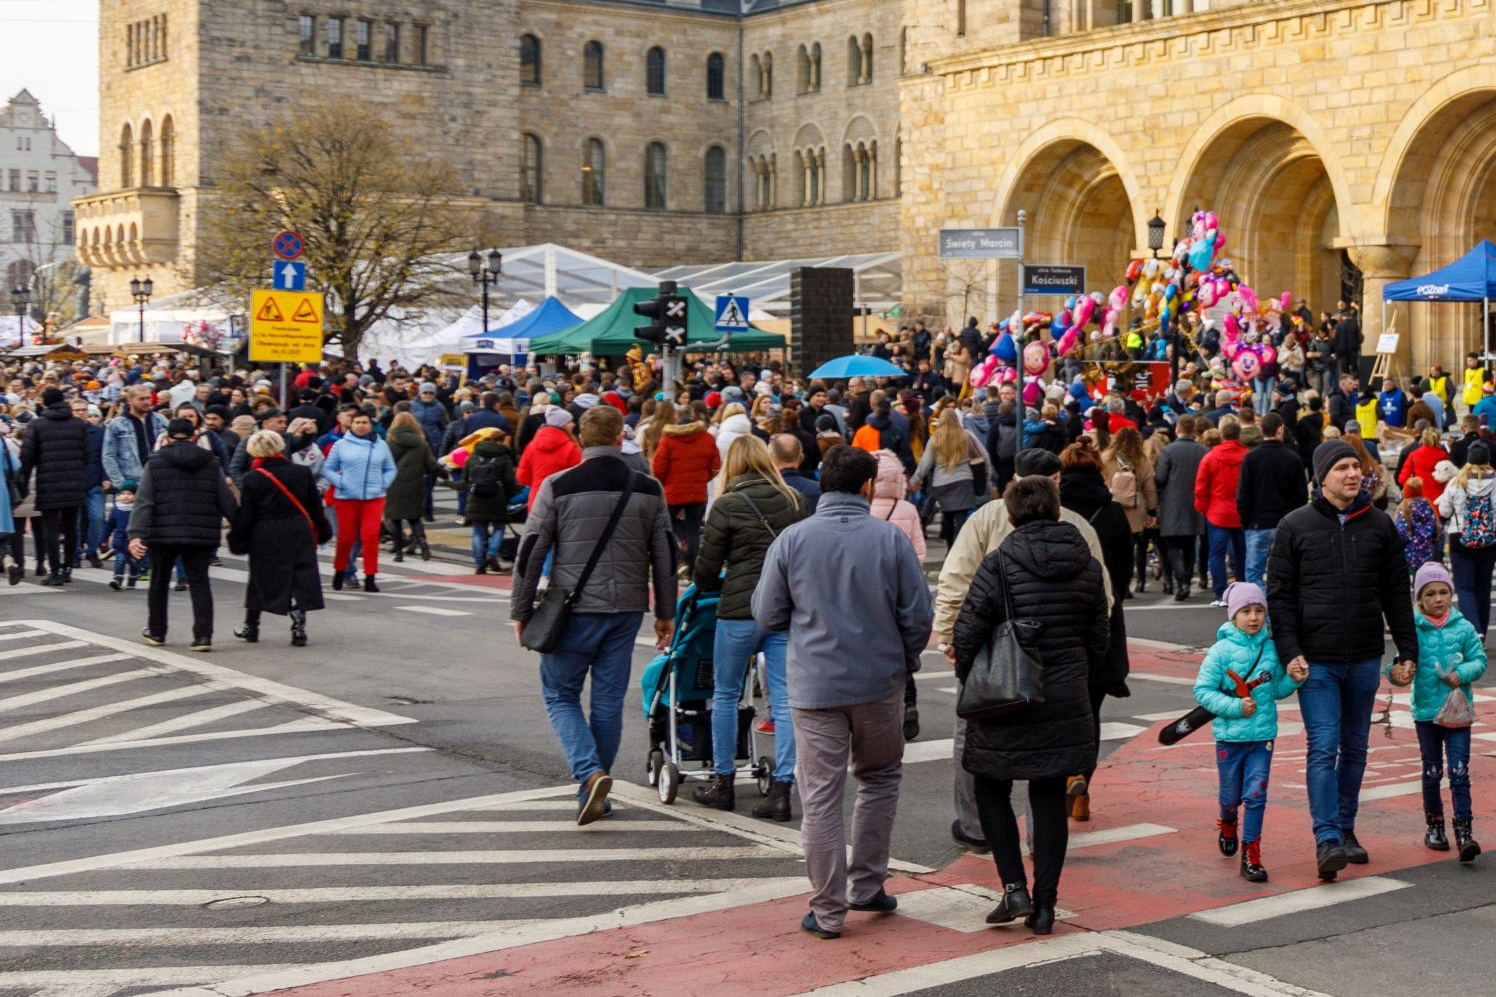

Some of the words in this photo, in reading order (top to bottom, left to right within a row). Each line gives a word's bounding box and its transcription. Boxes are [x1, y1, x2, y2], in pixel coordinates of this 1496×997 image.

[945, 235, 976, 250] Święty
[980, 237, 1013, 249] Marcin
[1031, 275, 1078, 285] Kościuszki
